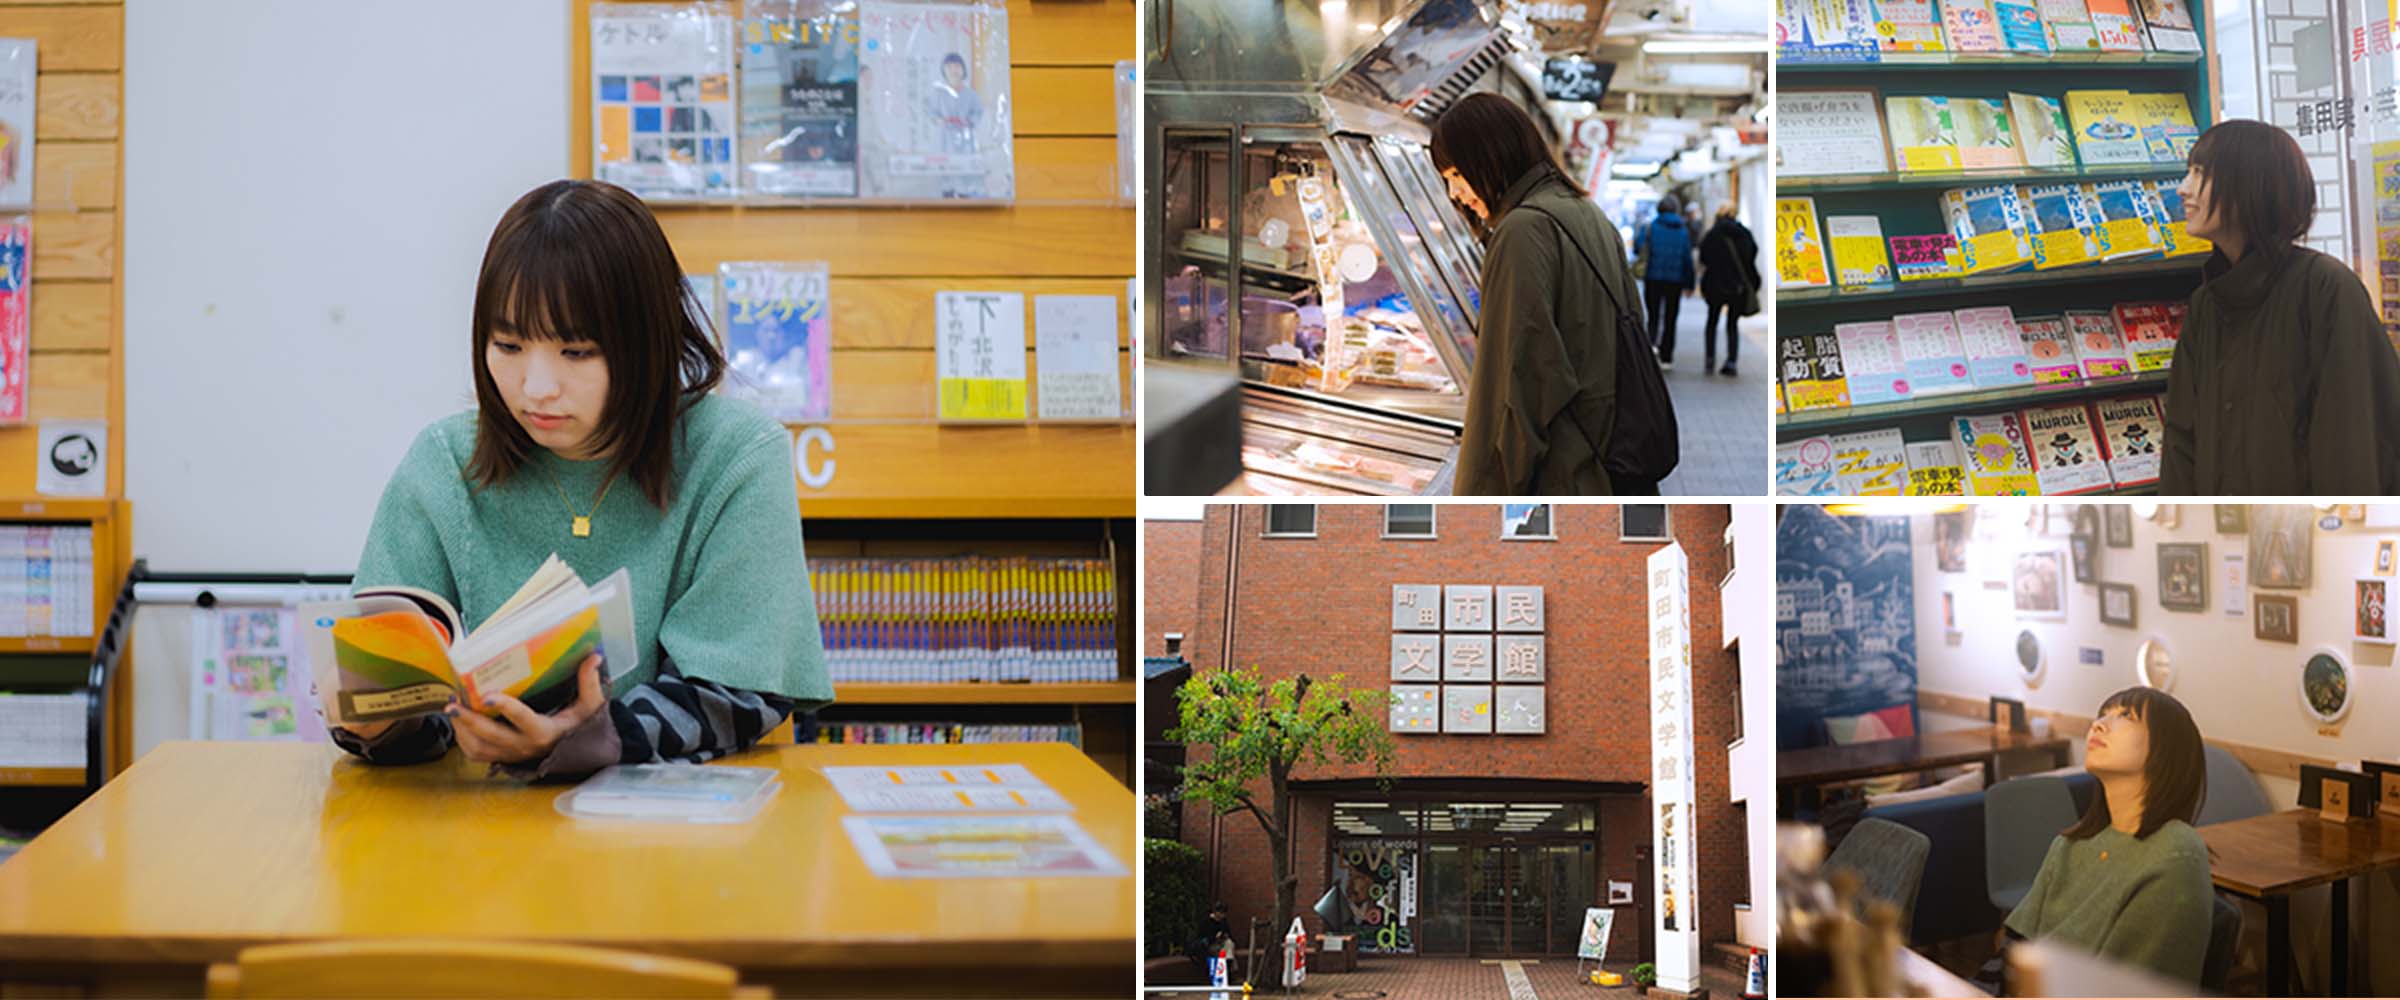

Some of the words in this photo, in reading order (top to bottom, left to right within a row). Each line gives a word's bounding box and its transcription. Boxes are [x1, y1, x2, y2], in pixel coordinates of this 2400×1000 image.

[1815, 335, 1844, 377] 脂質
[2030, 412, 2086, 431] MURDLE
[2102, 404, 2156, 421] MURDLE
[797, 428, 836, 489] C
[1399, 641, 1539, 677] 文学館
[1653, 567, 1677, 781] 町田市民文学館
